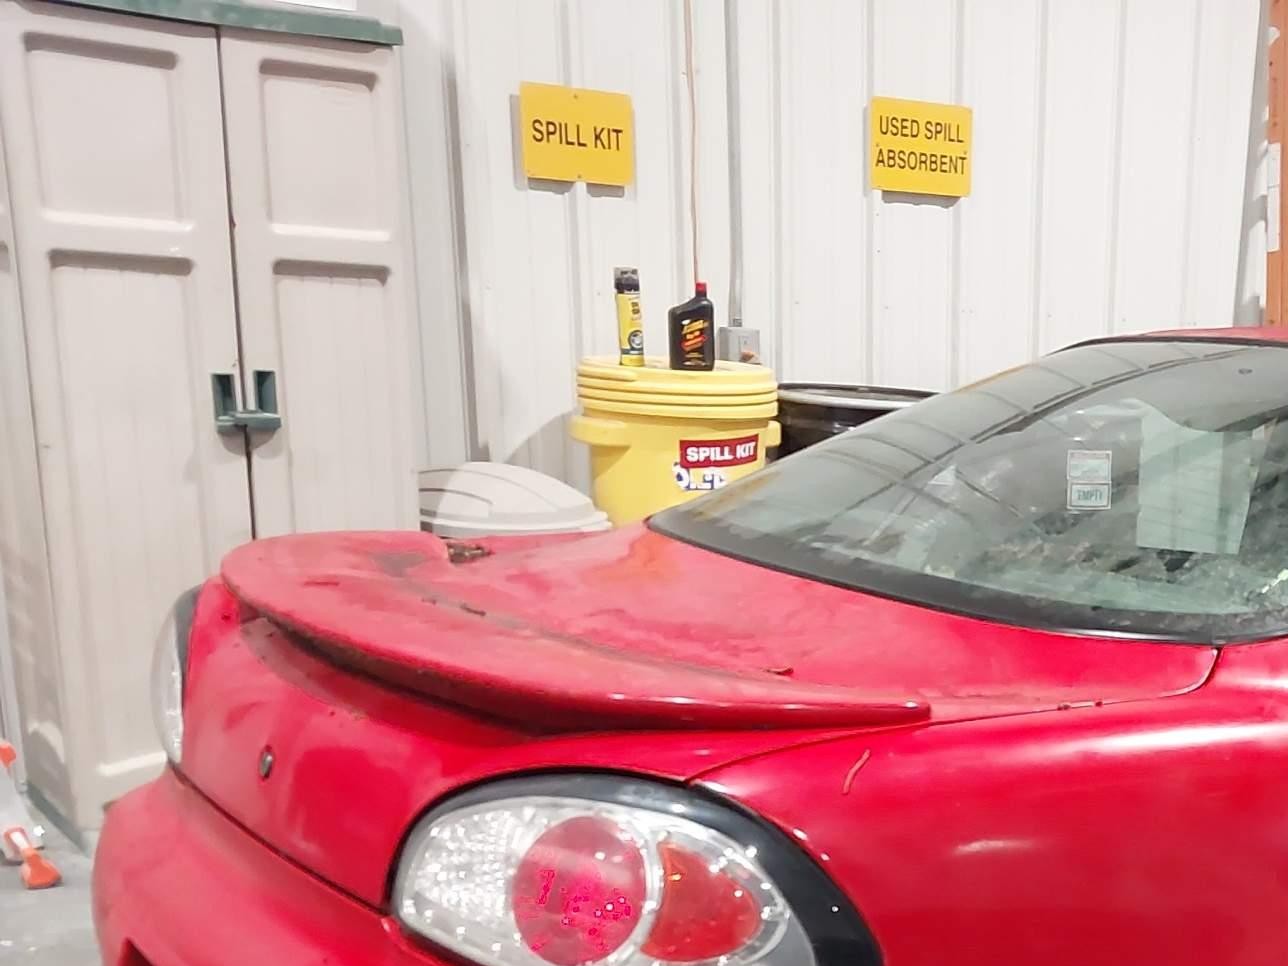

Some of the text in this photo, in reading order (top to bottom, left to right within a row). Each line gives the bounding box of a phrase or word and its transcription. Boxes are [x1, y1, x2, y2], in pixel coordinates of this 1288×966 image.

[531, 118, 624, 152] SPILL KIT
[879, 114, 965, 144] USED SPILL
[875, 147, 968, 175] ABSORBENT
[686, 441, 756, 462] SPILL KIT
